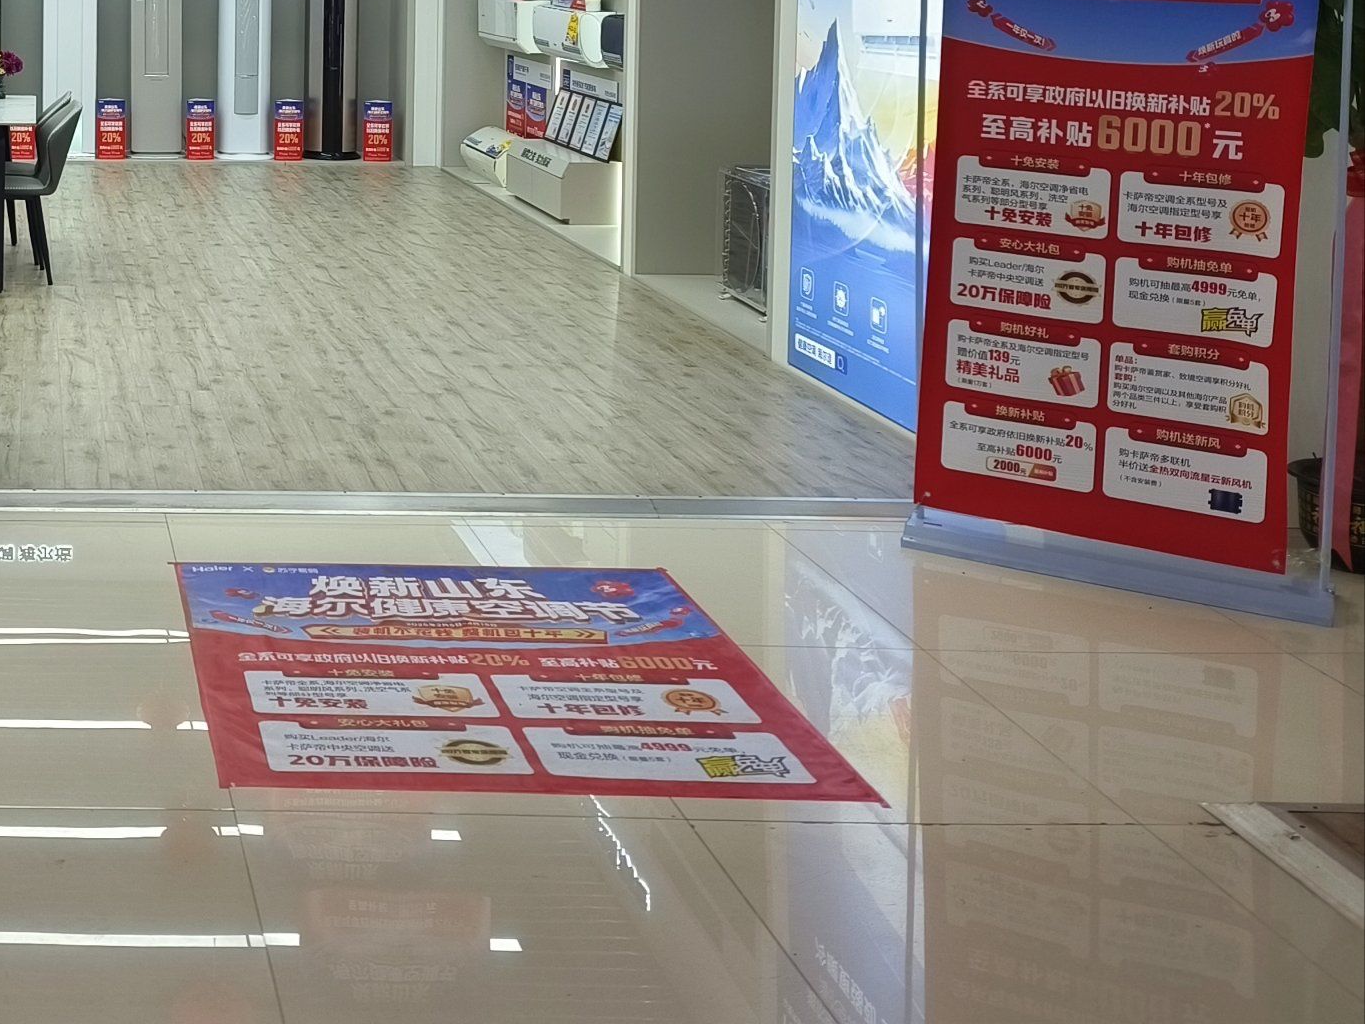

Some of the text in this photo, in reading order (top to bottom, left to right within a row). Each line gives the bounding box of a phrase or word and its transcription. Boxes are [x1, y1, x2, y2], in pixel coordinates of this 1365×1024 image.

[967, 80, 1280, 121] 全系可享政府以旧换新补贴20%
[1010, 155, 1060, 170] 十免安装
[1179, 171, 1232, 186] 十年包修
[984, 206, 1052, 228] 十免安装
[1127, 202, 1222, 220] 海尔空调指定型号享
[1134, 221, 1212, 243] 十年包修
[999, 238, 1060, 255] 安心大礼包
[969, 256, 1045, 274] 购买Leader/海尔
[1166, 256, 1233, 274] 购机抽免单
[968, 268, 1044, 287] 卡萨帝中央空调送
[957, 282, 1052, 310] 20万保障险
[1000, 321, 1050, 339] 购机好礼
[1201, 307, 1264, 337] 赢免单
[957, 346, 1021, 366] 赠价值139元
[1167, 343, 1220, 360] 套购积分
[956, 359, 1020, 384] 精美礼品
[995, 404, 1045, 422] 换新补贴
[1113, 399, 1137, 410] 分好礼
[1156, 428, 1221, 449] 购机送新风
[976, 442, 1063, 464] 至高补贴6000元
[1118, 447, 1191, 468] 购卡萨帝多联机
[192, 565, 234, 573] Haier
[309, 576, 546, 599] 焕新山东
[260, 596, 642, 619] 海尔健康空调节
[268, 696, 370, 710] 十免安装
[536, 702, 646, 717] 十年包修
[337, 718, 430, 728] 安心大礼包
[288, 754, 440, 769] 20万保障险
